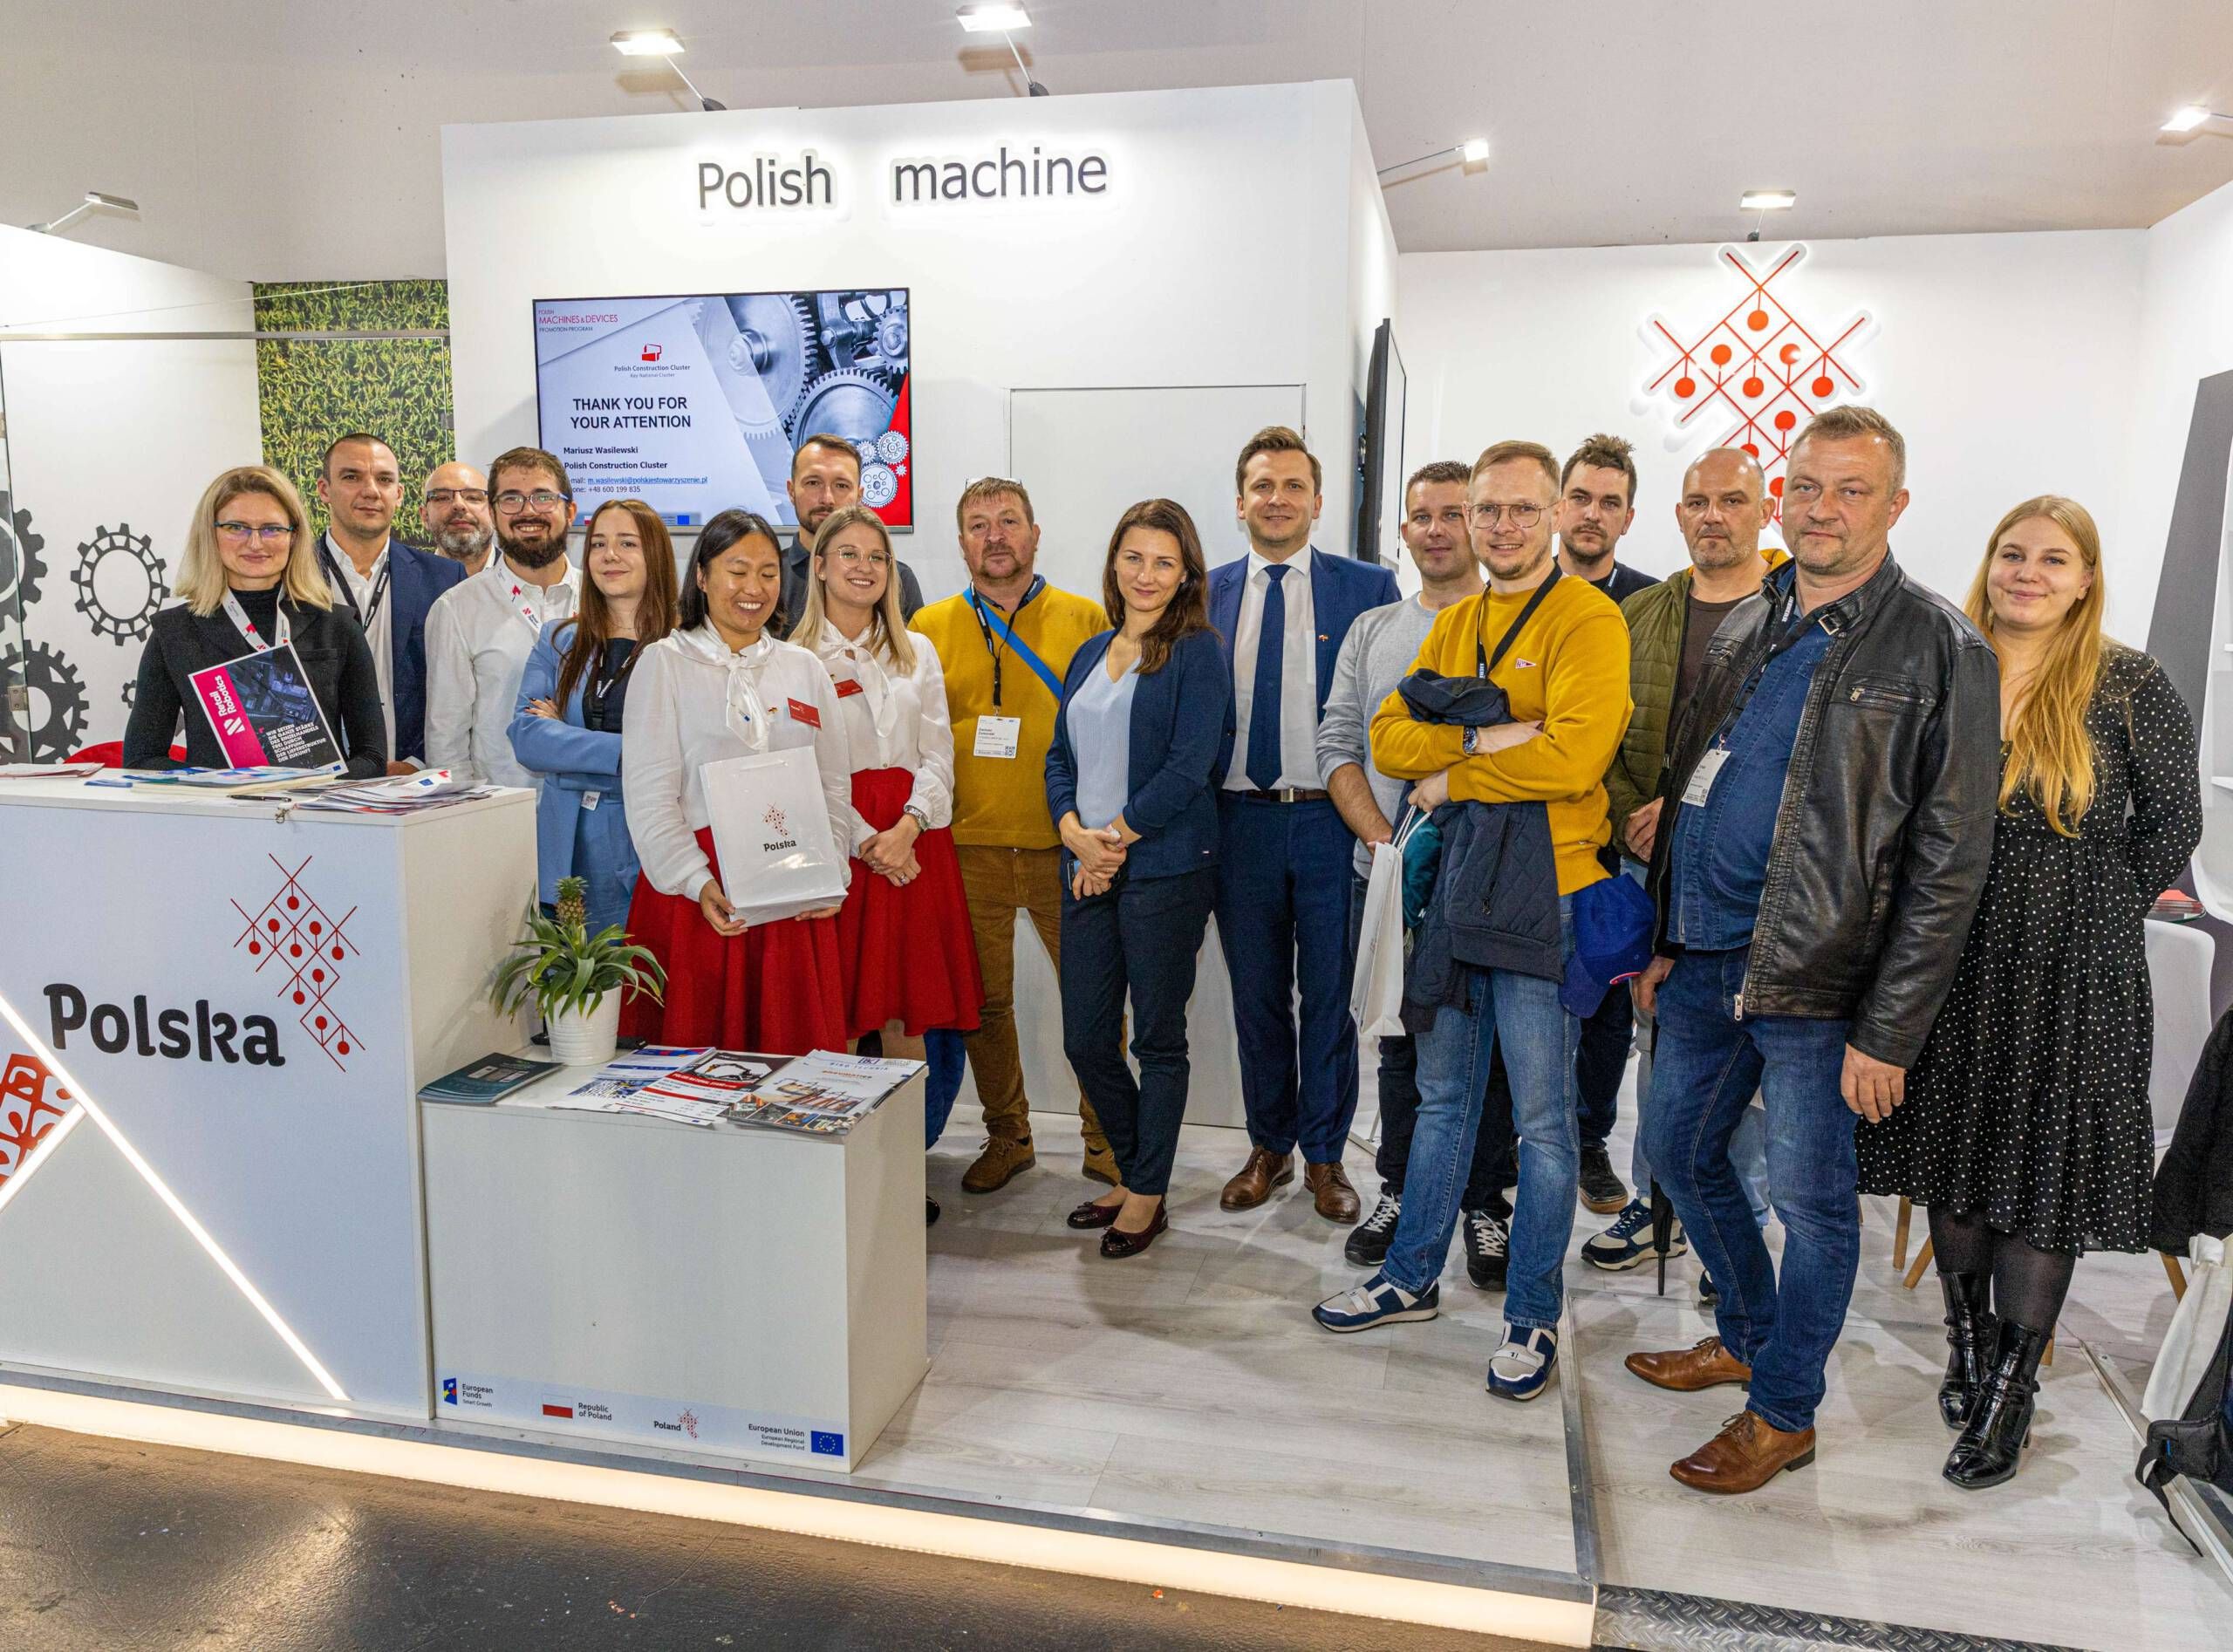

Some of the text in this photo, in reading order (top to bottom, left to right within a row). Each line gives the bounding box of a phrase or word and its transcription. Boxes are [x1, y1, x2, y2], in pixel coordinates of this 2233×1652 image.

[698, 147, 1107, 209] Polish machine
[538, 315, 580, 324] MACHINES
[585, 314, 618, 323] DEVICES
[572, 397, 687, 411] THANK YOU FOR
[570, 415, 691, 428] YOUR ATTENTION
[215, 675, 237, 713] Robotics
[209, 691, 228, 717] Retail
[763, 840, 797, 851] Polska
[44, 983, 285, 1067] Polska
[461, 1383, 494, 1394] European
[462, 1390, 482, 1399] Funds
[577, 1402, 609, 1413] Republic
[587, 1411, 612, 1421] Poland
[653, 1420, 681, 1431] Poland
[748, 1423, 805, 1437] European Union
